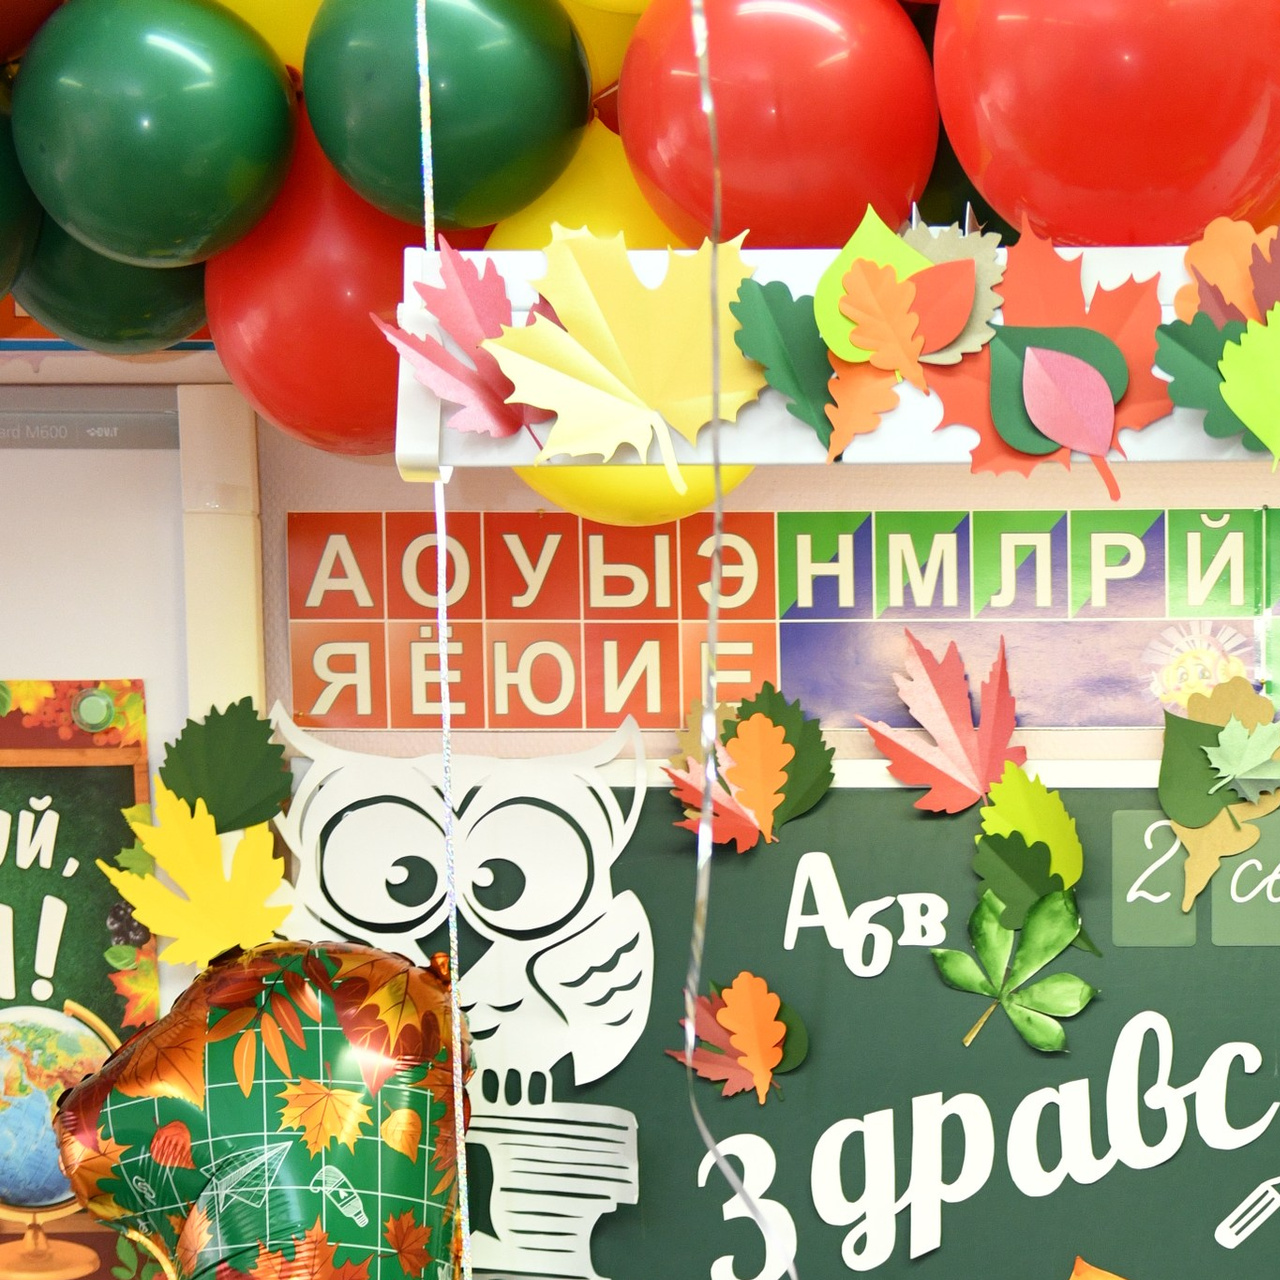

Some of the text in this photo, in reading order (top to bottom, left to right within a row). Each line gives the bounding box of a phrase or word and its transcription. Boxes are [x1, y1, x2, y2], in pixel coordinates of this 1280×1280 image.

[25, 425, 67, 438] M600
[305, 534, 374, 607] А
[401, 533, 470, 608] О
[503, 534, 562, 607] У
[589, 534, 671, 607] Ы
[697, 533, 758, 609] Э
[796, 534, 854, 607] Н
[888, 533, 958, 607] М
[990, 533, 1051, 608] Л
[1090, 532, 1146, 607] Р
[1186, 513, 1244, 606] Й
[310, 642, 372, 715] Я
[410, 625, 466, 715] Ё
[494, 641, 576, 716] Ю
[603, 641, 661, 714] И
[0, 795, 80, 877] Й,
[1126, 819, 1181, 904] 2
